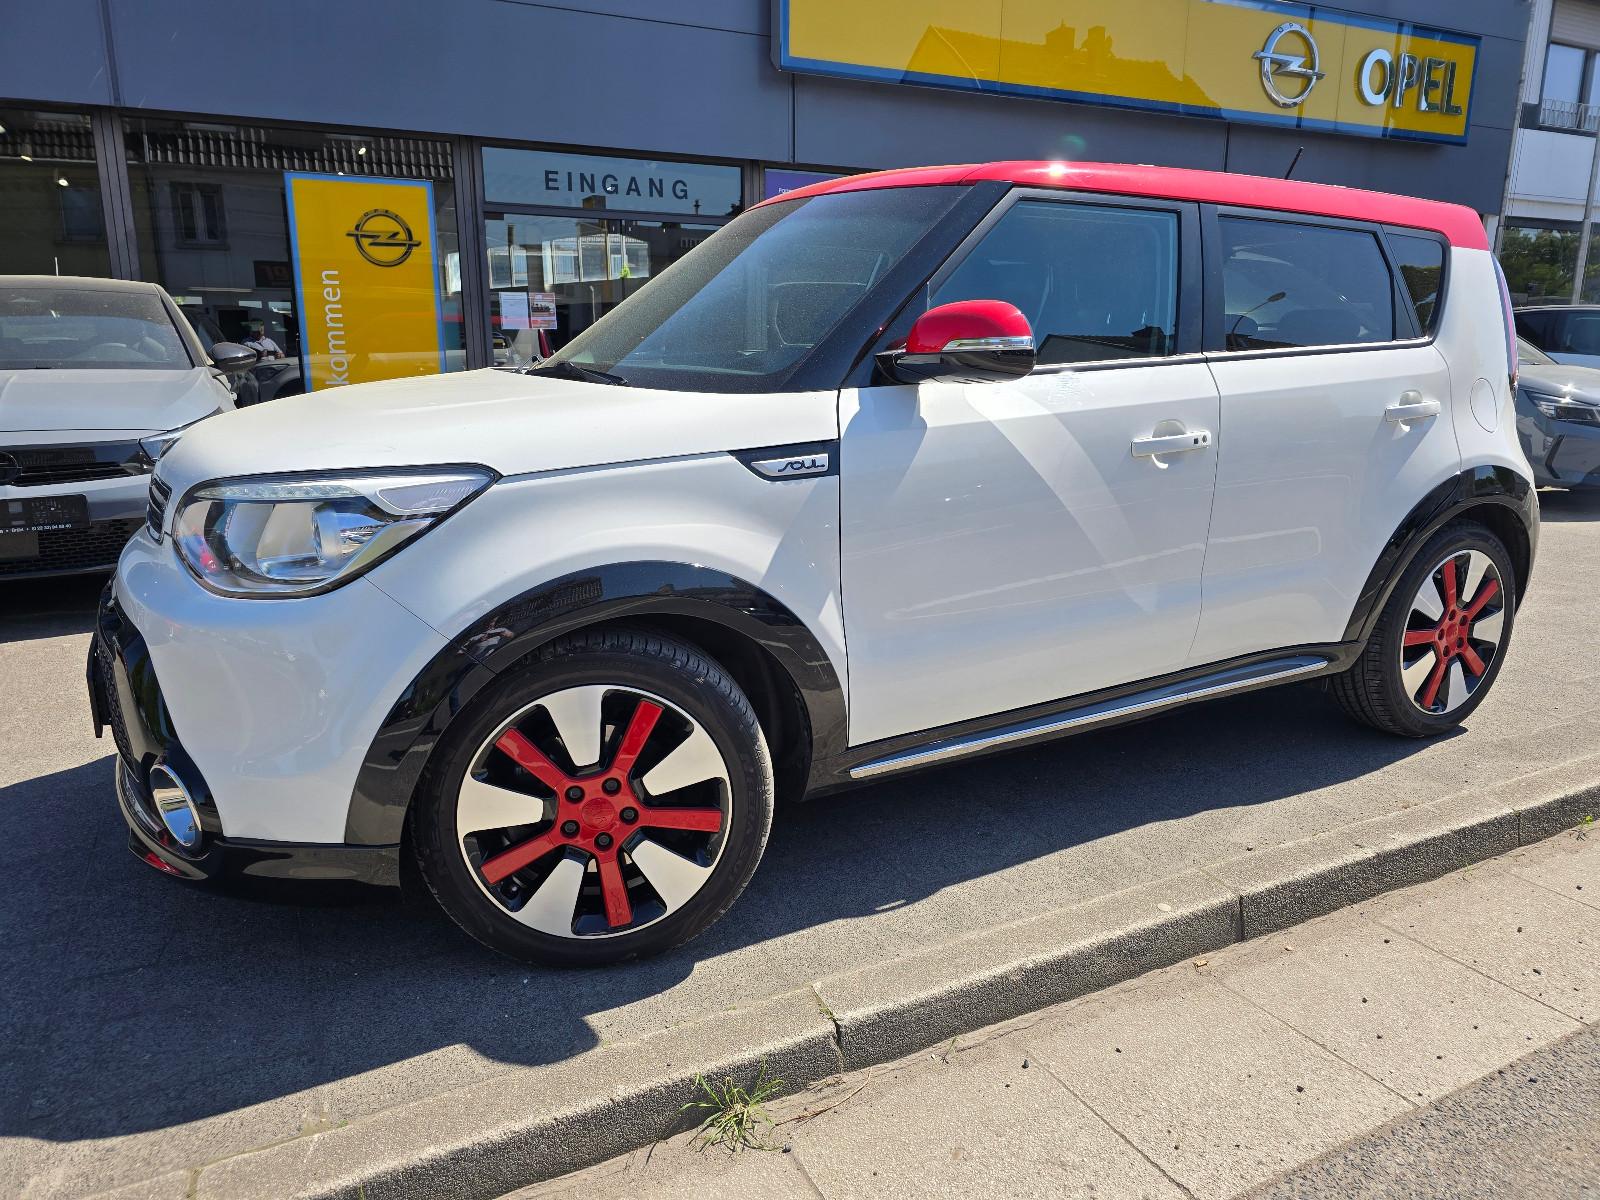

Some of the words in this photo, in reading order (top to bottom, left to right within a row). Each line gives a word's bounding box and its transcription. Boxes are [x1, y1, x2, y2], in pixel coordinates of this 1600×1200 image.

[1357, 48, 1463, 115] OPEL
[544, 169, 689, 200] EINGANG
[321, 269, 350, 385] kommen
